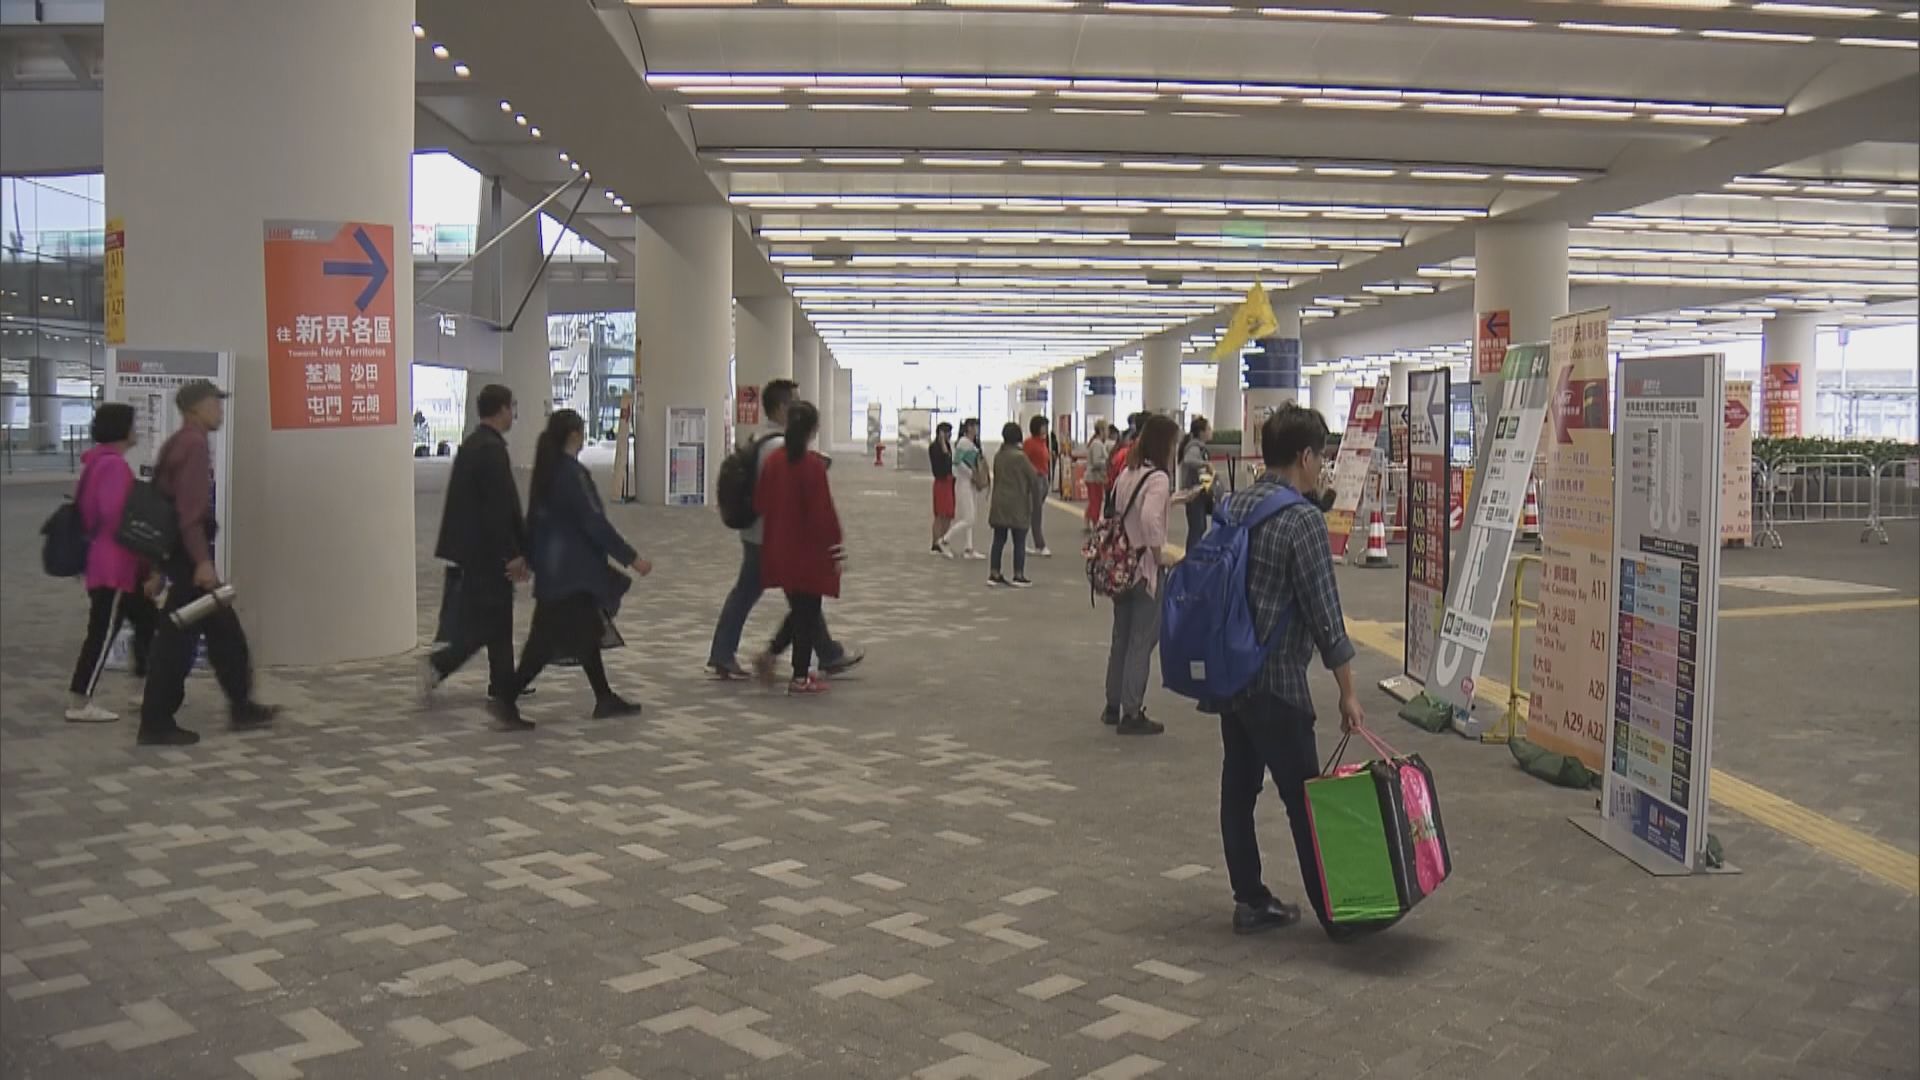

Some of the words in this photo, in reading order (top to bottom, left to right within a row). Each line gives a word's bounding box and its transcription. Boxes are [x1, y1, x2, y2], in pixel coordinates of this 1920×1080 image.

[276, 326, 292, 342] 往
[295, 314, 392, 344] 新界各區
[320, 347, 343, 358] New
[344, 346, 386, 358] Territories
[350, 363, 378, 383] 沙田
[307, 395, 342, 416] 屯門
[351, 394, 380, 414] 元朗
[1411, 422, 1432, 446] 巴士站
[1412, 557, 1425, 581] A41
[1591, 578, 1606, 602] A11
[1590, 627, 1605, 652] A21
[1588, 678, 1605, 701] A29
[1562, 709, 1584, 737] A29,
[1587, 719, 1605, 743] A22
